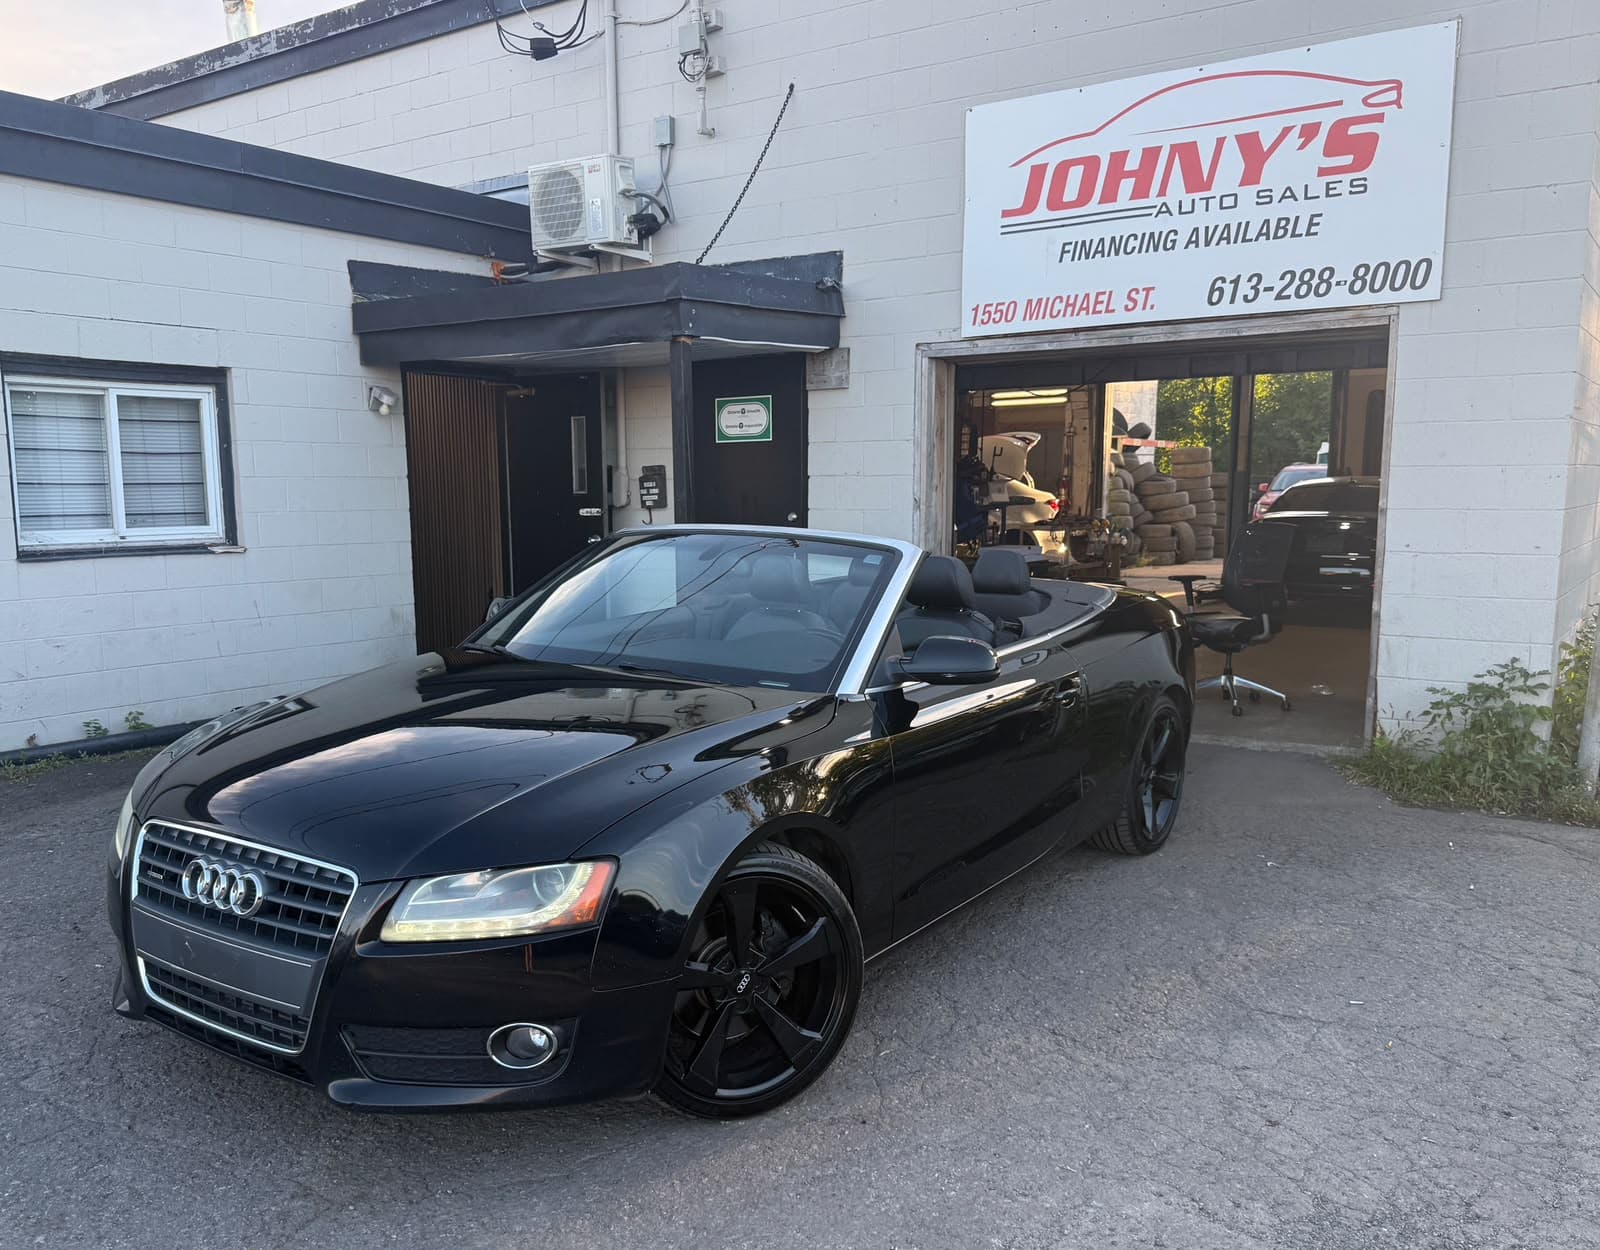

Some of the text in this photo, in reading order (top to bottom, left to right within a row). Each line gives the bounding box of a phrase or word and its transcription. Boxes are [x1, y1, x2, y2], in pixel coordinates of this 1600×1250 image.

[1001, 112, 1385, 219] JOHNY'S
[1154, 177, 1368, 218] AUTO SALES
[1058, 213, 1323, 263] FINANCING AVAILABLE
[971, 286, 1156, 327] 1550 MICHAEL ST.
[1207, 257, 1433, 307] 613-288-8000
